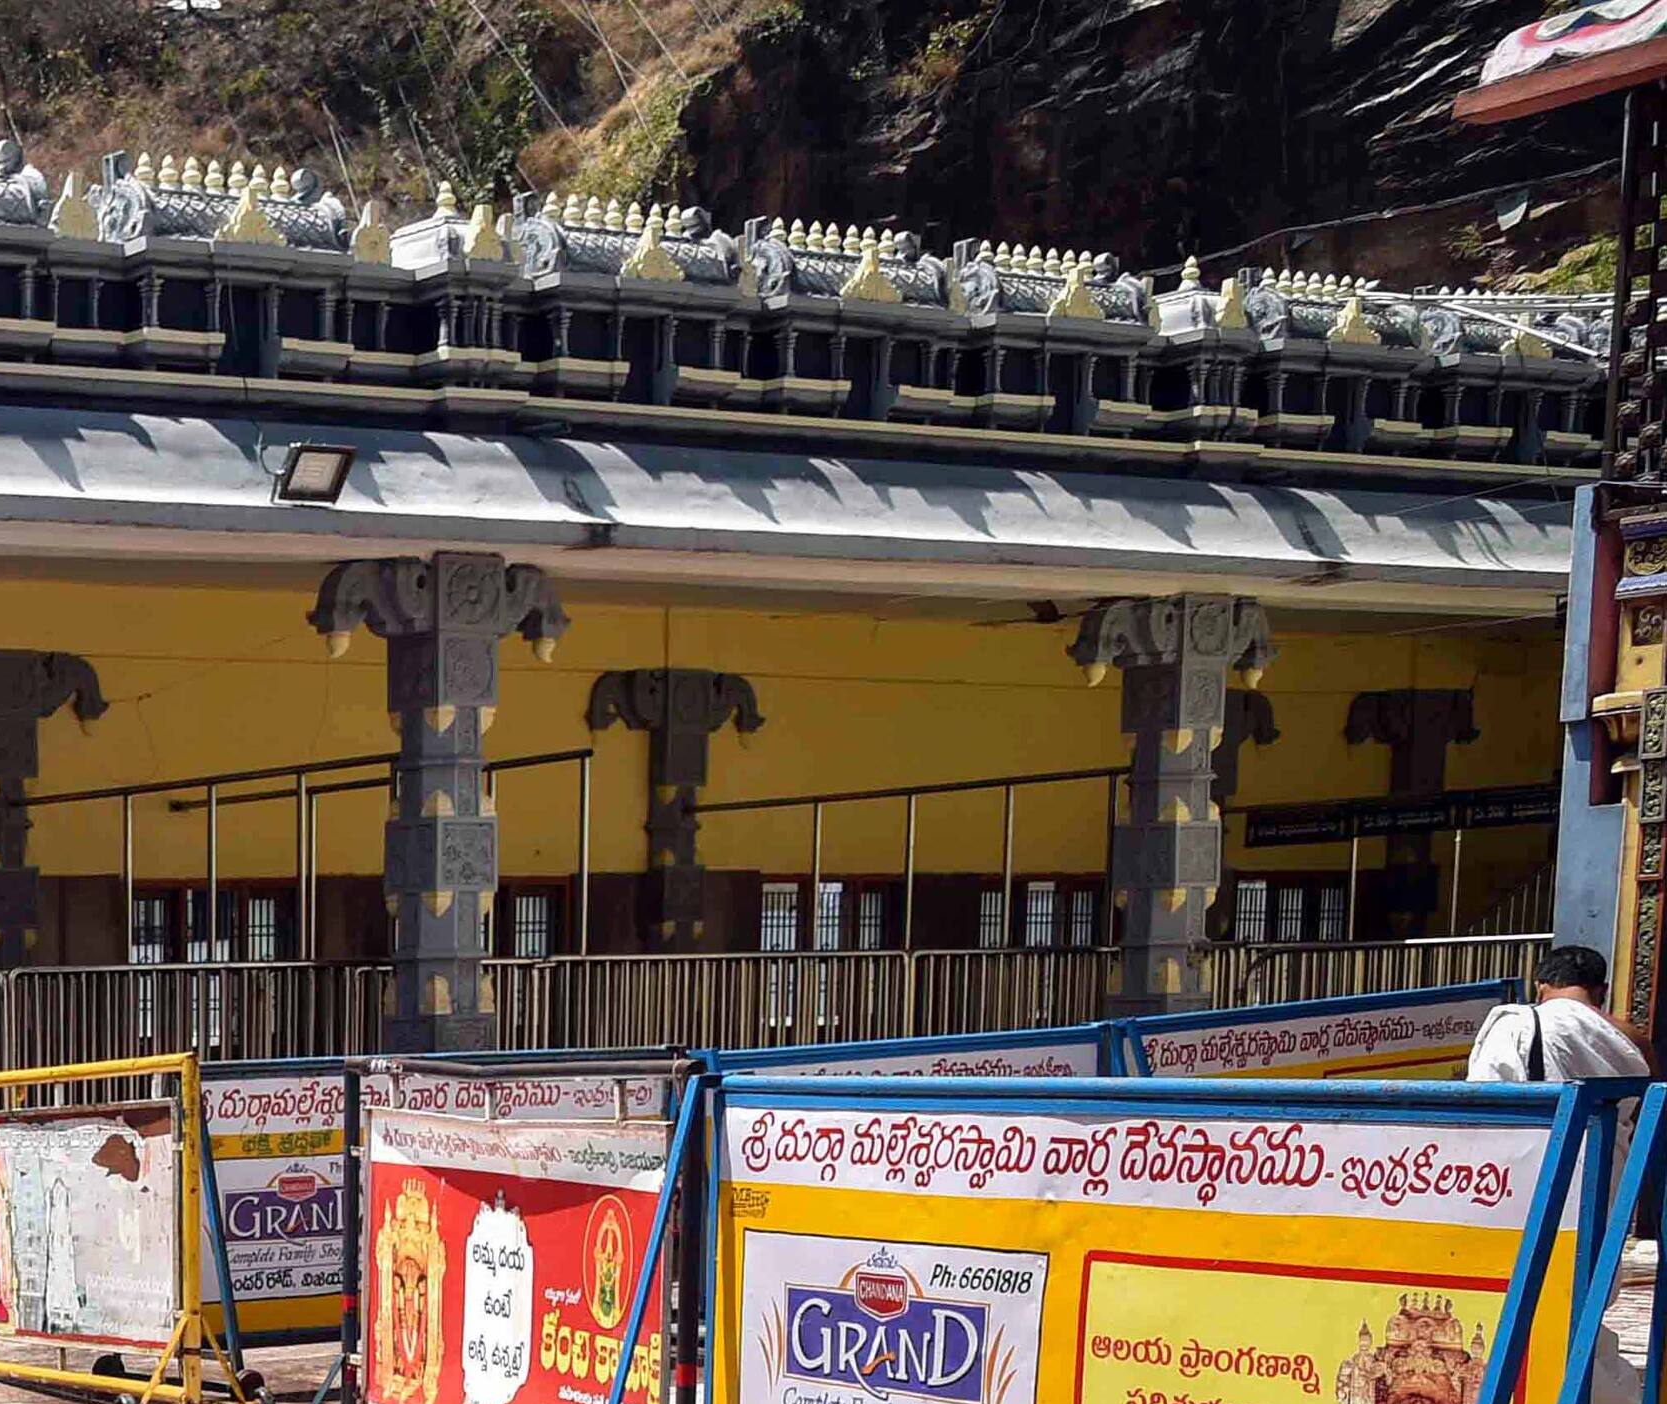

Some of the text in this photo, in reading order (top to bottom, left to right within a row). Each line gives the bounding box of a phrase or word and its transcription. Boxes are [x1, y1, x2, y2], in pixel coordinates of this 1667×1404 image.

[740, 1110, 776, 1173] శ్రీ
[774, 1118, 846, 1182] దుర్గా
[1043, 1126, 1117, 1197] వార్ల
[229, 1247, 274, 1267] omplete
[473, 1241, 525, 1277] అమ్మ దయ
[858, 1280, 905, 1302] CHANDANA
[958, 1266, 1034, 1295] 6661818
[484, 1289, 513, 1319] ఉంటే
[790, 1297, 979, 1400] GRAND
[1091, 1334, 1321, 1395] ఆలయ ప్రాంగణాన్ని
